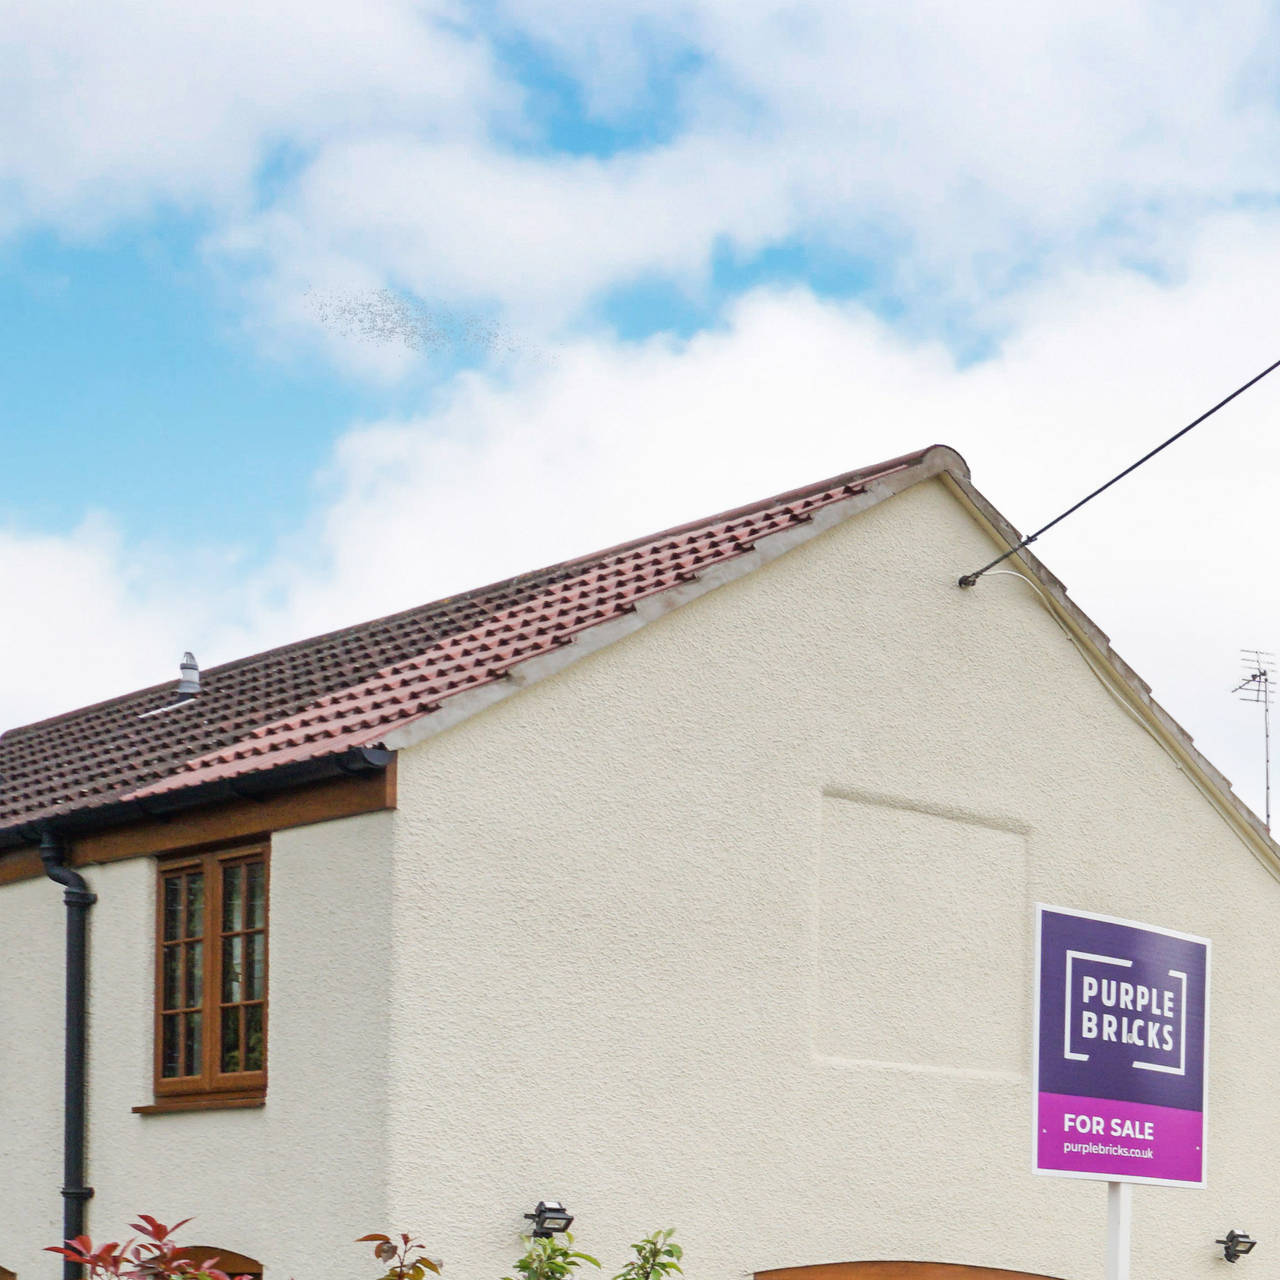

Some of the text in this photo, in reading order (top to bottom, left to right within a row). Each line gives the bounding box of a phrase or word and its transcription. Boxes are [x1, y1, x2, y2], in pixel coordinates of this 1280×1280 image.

[1082, 975, 1174, 1018] PURPLE
[1081, 1010, 1174, 1051] BRICKS
[1064, 1113, 1154, 1140] FOR SALE
[1063, 1142, 1154, 1159] purplebricks.co.uk
